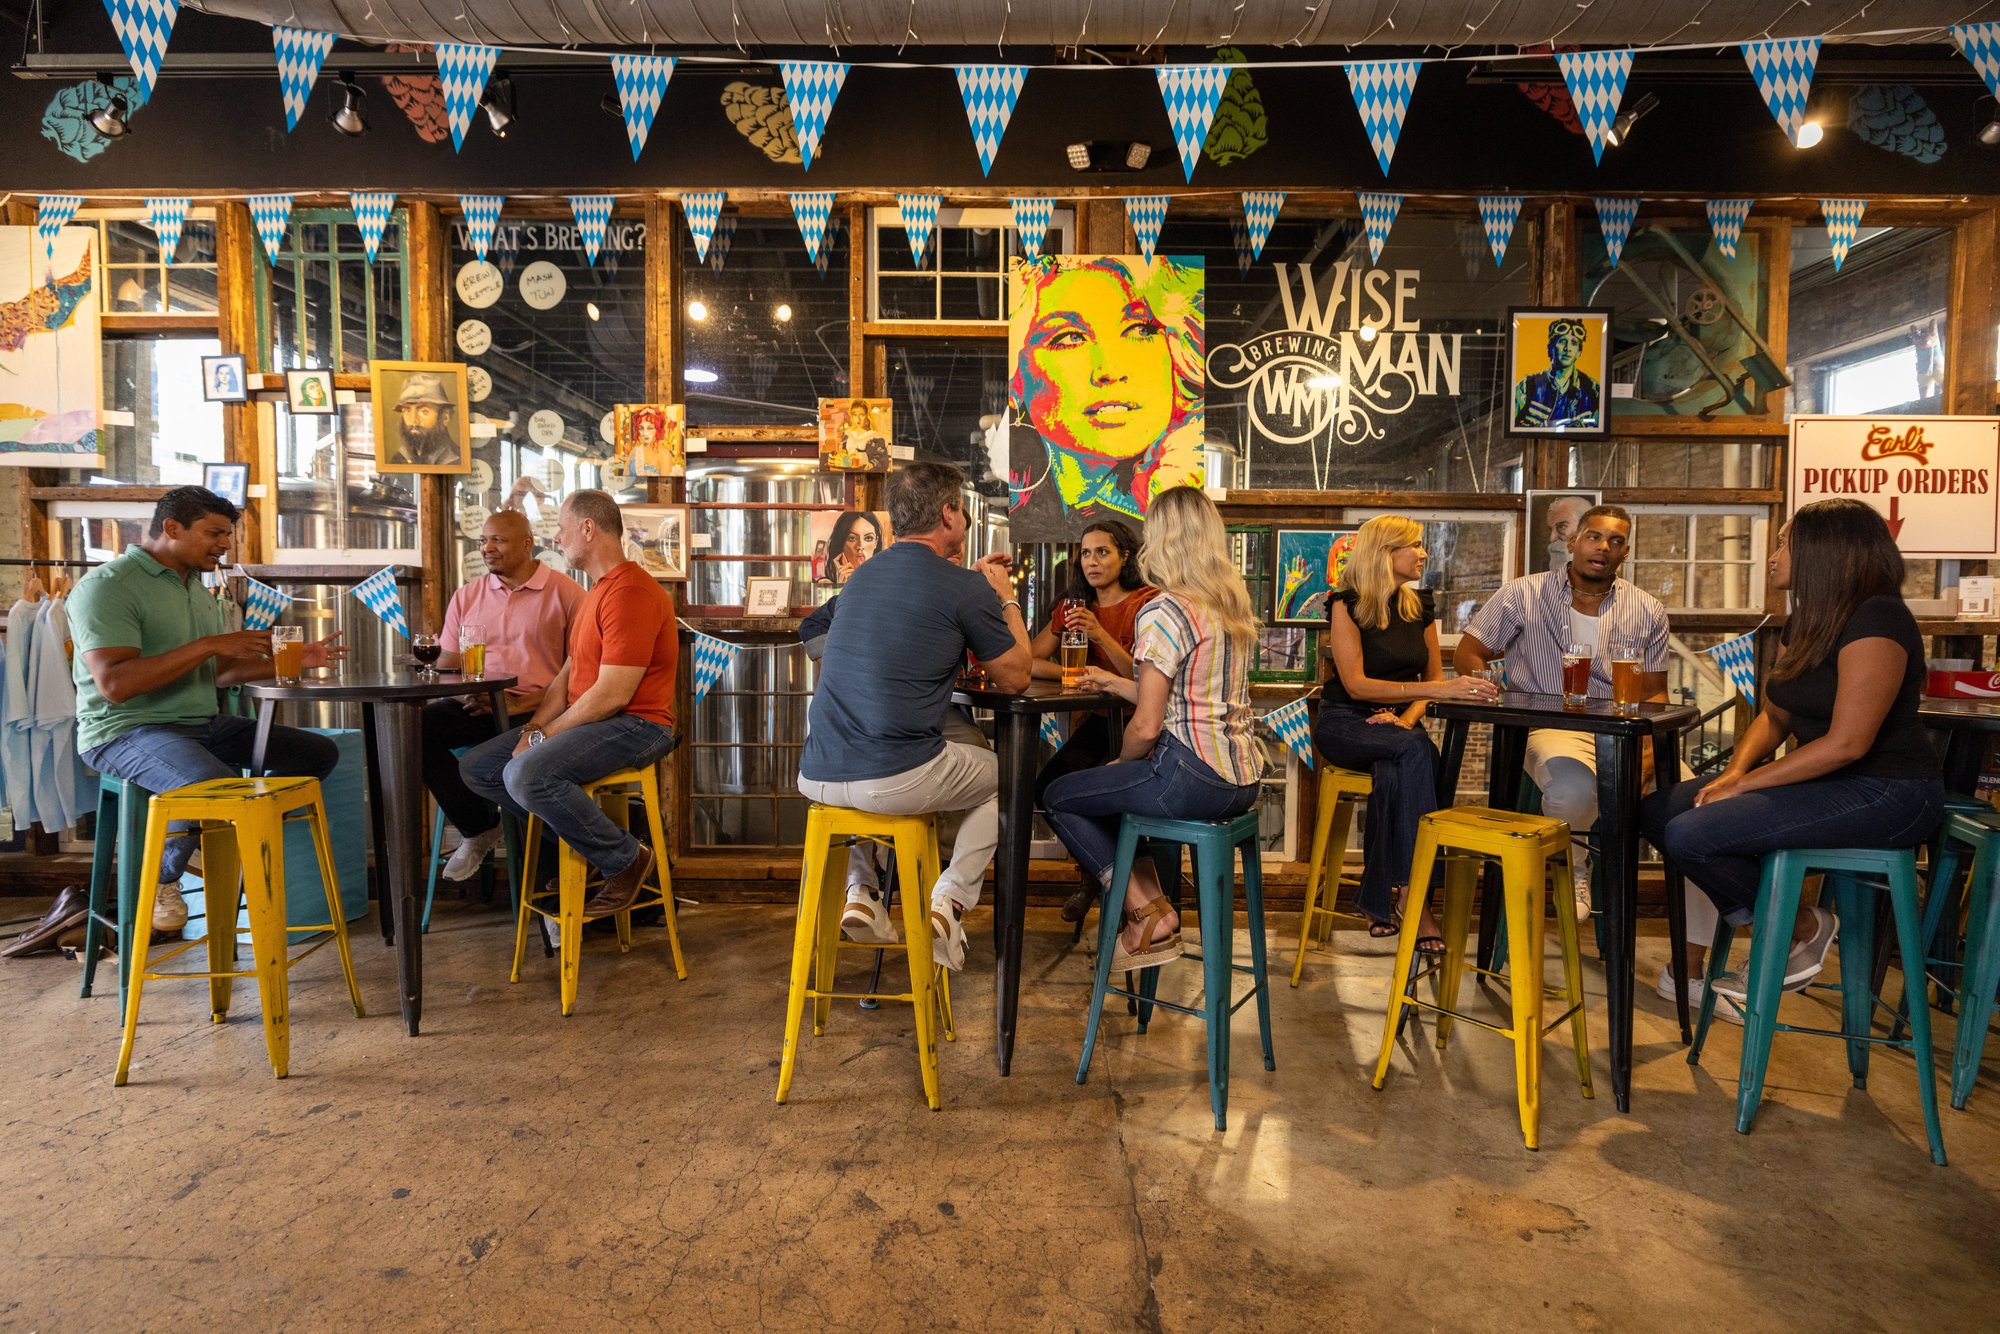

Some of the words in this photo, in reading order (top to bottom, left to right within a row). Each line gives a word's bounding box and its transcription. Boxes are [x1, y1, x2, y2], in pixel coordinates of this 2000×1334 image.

[456, 222, 539, 250] WAT'S
[545, 222, 647, 250] BREING?
[462, 270, 490, 291] BREW
[468, 280, 501, 302] KETTLE
[526, 272, 553, 287] MASH
[1273, 257, 1421, 337] WISE
[1249, 336, 1337, 362] BREWING
[1338, 331, 1463, 405] MAN
[1861, 424, 1934, 467] Earl's
[1803, 468, 1888, 494] PICKUP
[1897, 468, 1989, 494] ORDERS
